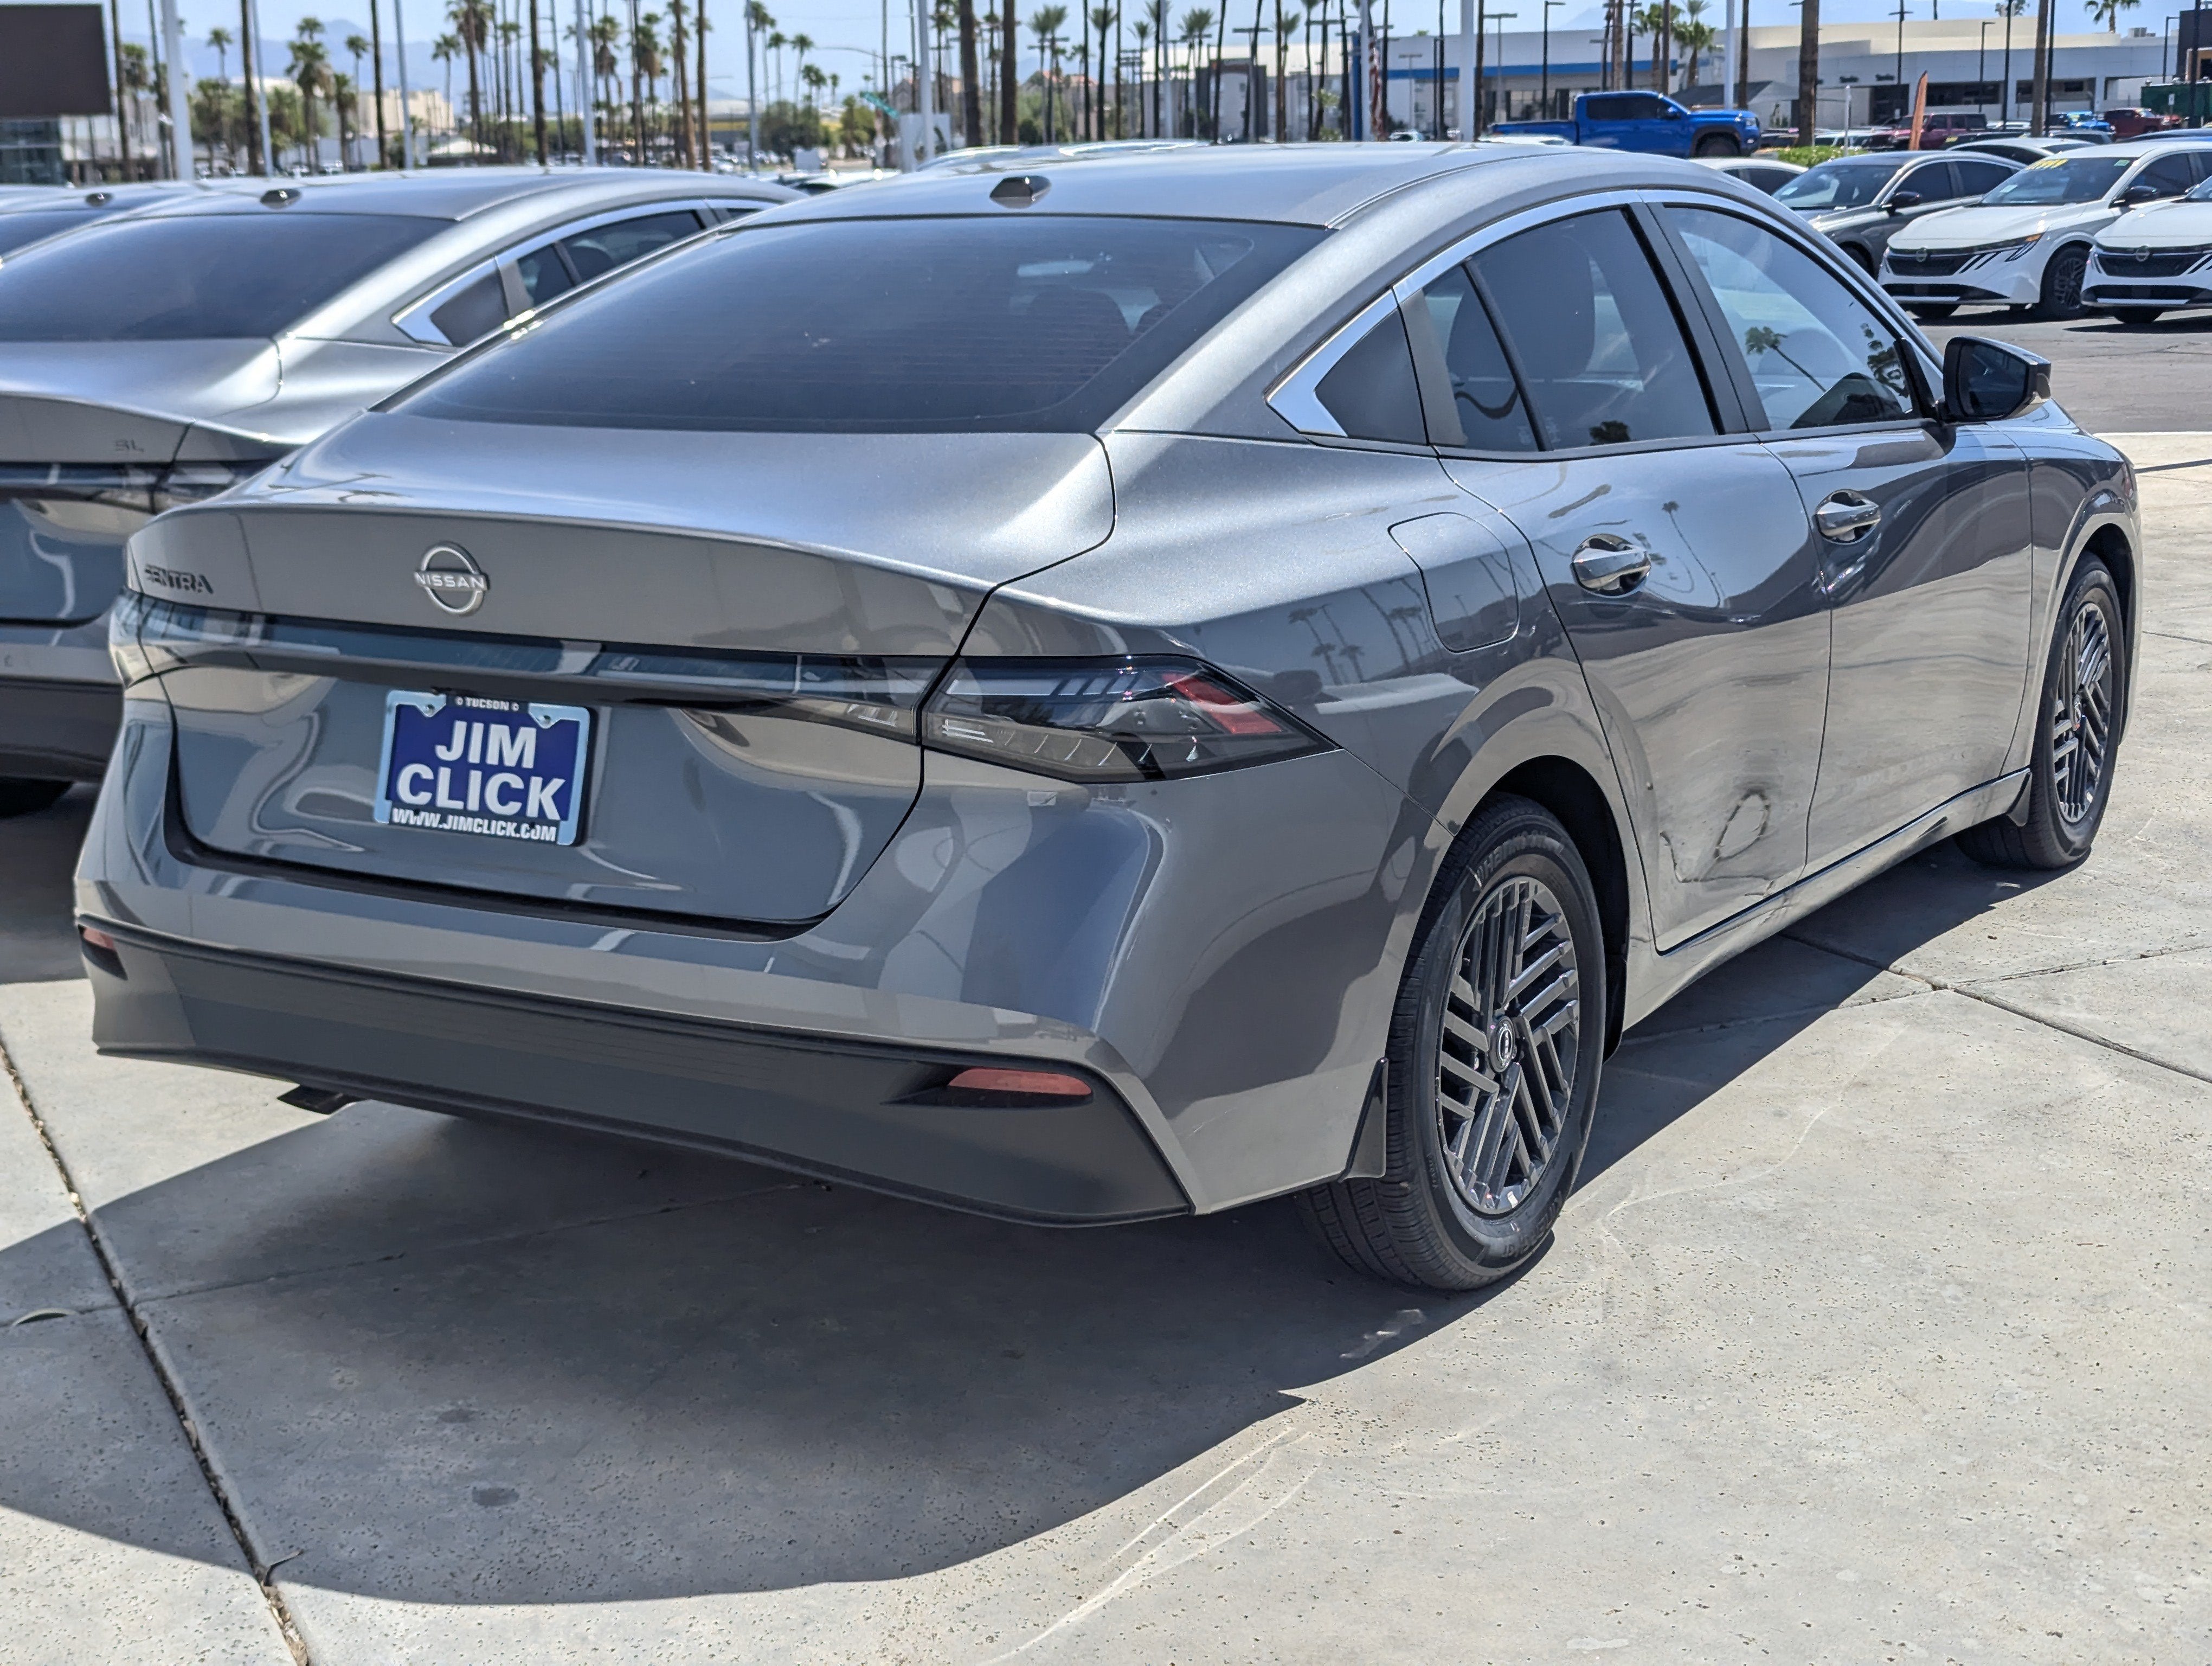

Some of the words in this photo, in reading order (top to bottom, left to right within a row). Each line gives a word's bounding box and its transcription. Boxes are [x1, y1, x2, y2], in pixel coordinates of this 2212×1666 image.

[413, 571, 485, 590] NISSAN
[465, 697, 510, 711] TUCSON
[435, 720, 537, 768] JIM
[396, 763, 566, 821] CLICK
[392, 808, 557, 841] WWW.JIMCLICK.COM
